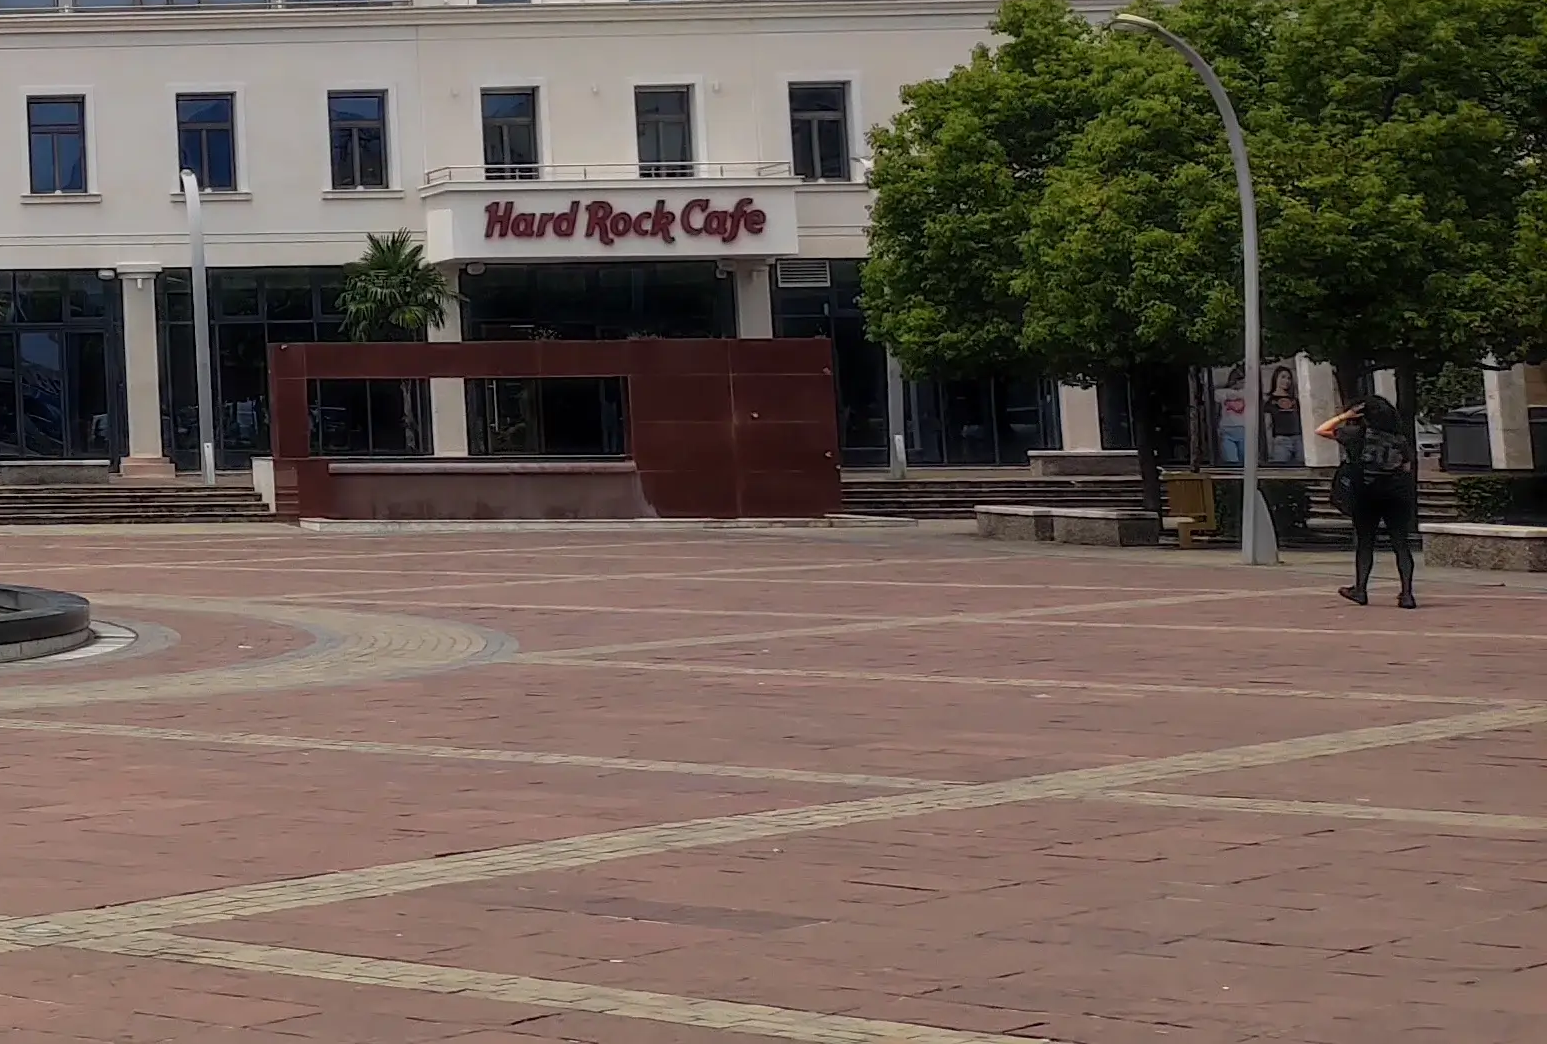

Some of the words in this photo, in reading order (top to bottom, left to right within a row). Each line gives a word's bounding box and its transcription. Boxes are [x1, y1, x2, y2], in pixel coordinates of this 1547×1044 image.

[484, 200, 580, 239] Hard
[585, 199, 676, 245] Rock
[680, 197, 767, 243] Cafe
